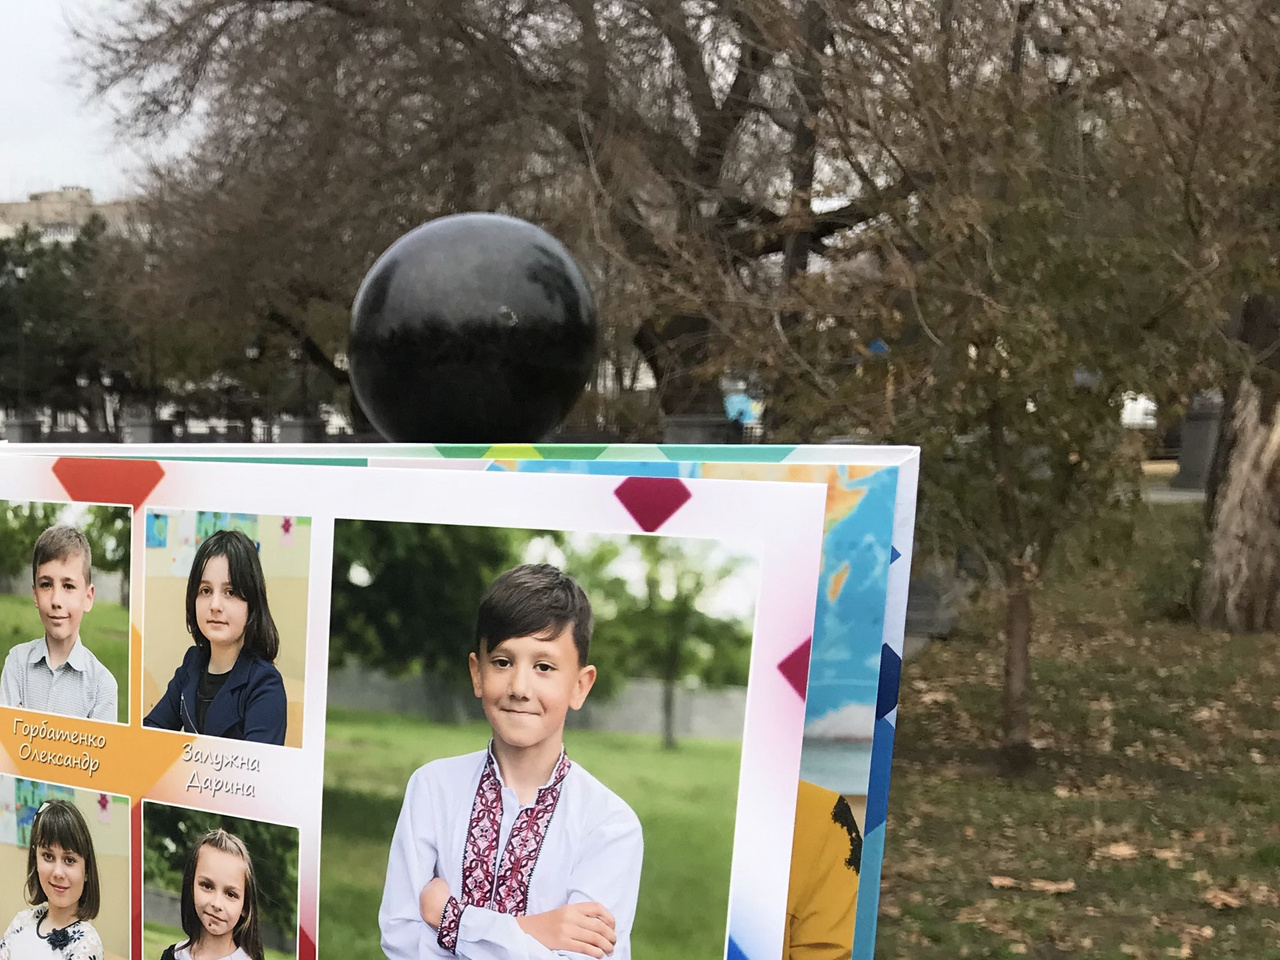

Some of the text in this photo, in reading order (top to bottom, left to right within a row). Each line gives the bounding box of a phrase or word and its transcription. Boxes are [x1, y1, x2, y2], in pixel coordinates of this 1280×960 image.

[13, 718, 107, 749] Горбатенко
[18, 743, 100, 777] Олександр
[181, 742, 261, 772] Залужна
[185, 770, 256, 798] Дарина
